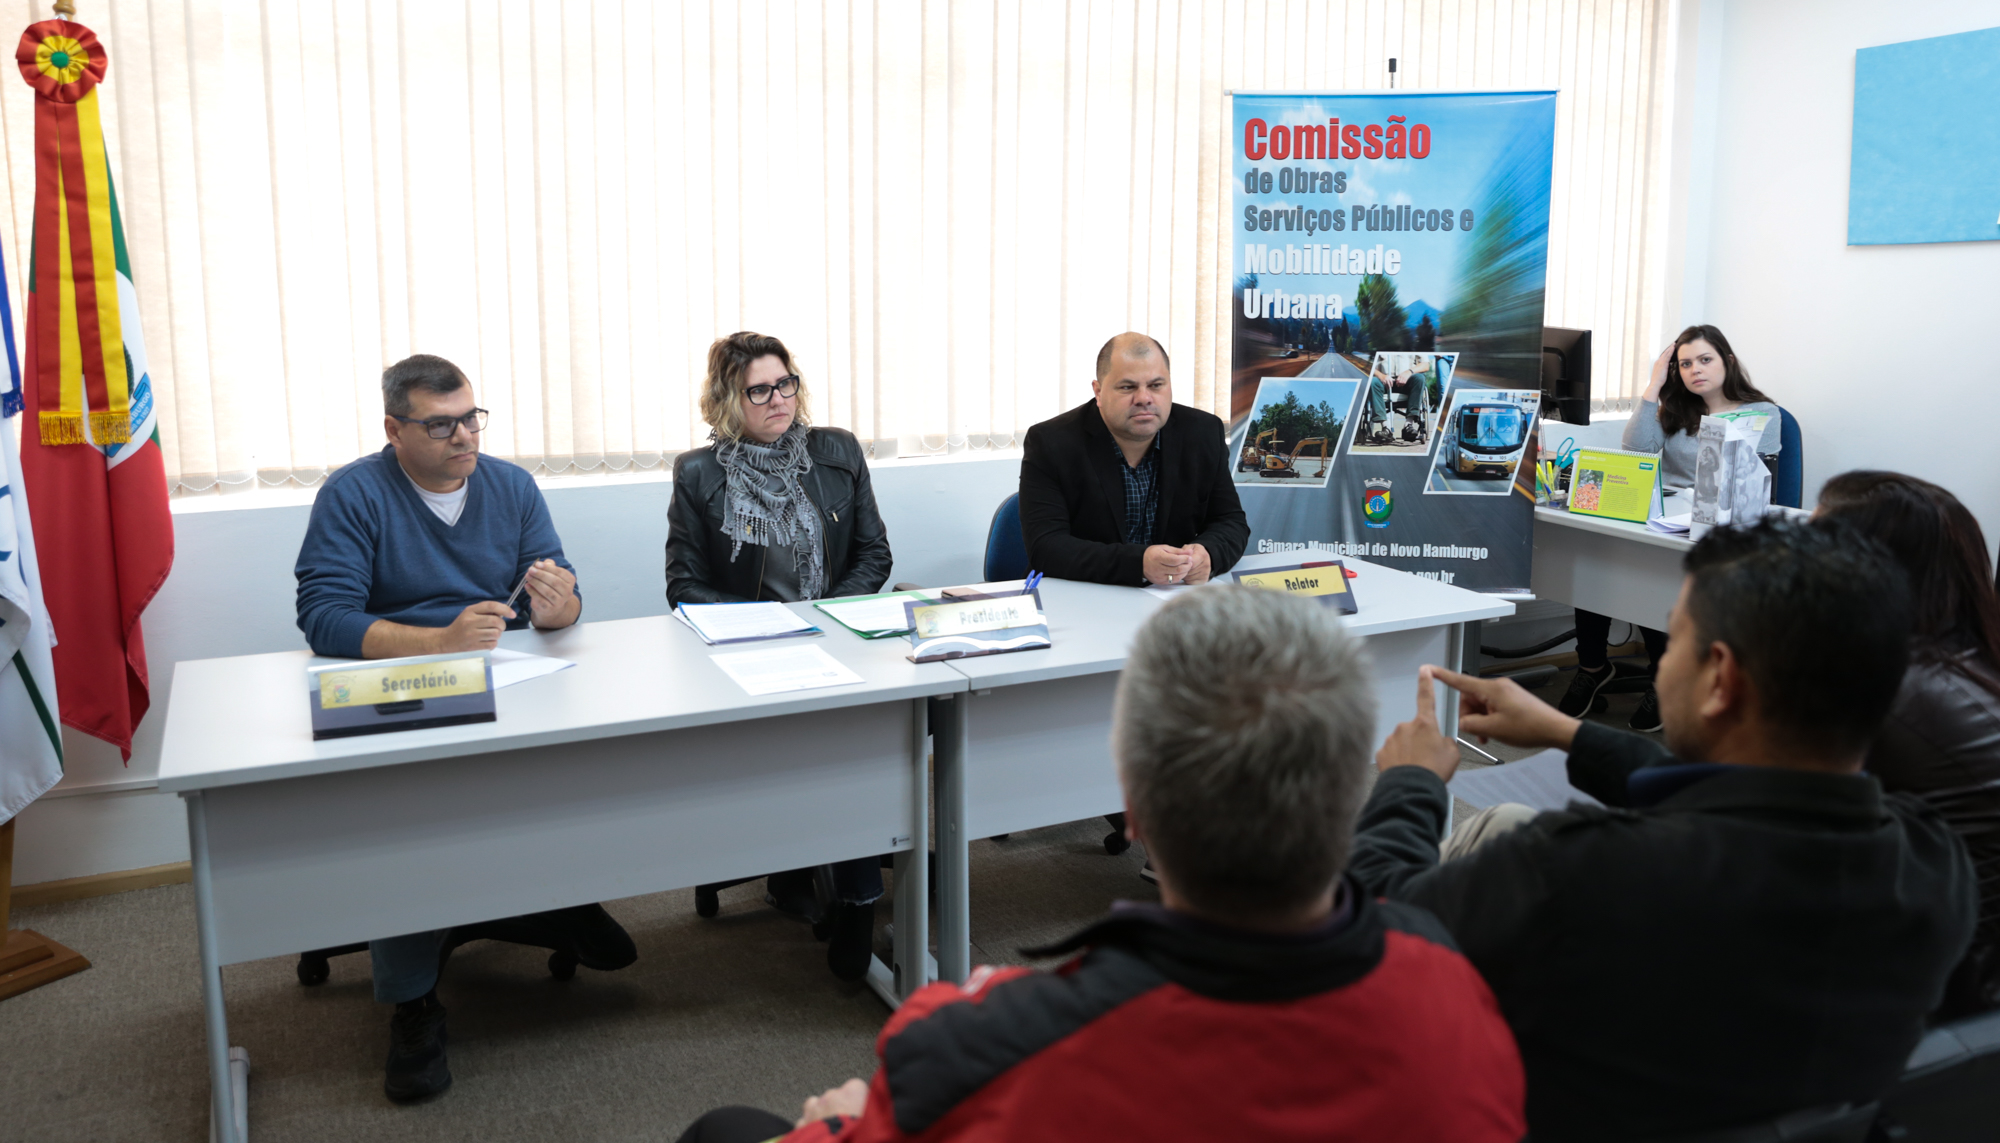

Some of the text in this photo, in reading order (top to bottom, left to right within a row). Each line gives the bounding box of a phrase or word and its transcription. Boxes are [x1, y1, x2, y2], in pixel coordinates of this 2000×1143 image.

[1244, 115, 1431, 160] Comissão
[1244, 167, 1347, 194] de Obras
[1244, 204, 1474, 236] Serviços Públicos e
[1244, 243, 1401, 275] Mobilidade
[1243, 288, 1343, 320] Urbana
[1257, 539, 1489, 561] Câmara Municipal de Novo Hamburgo
[1284, 577, 1320, 591] Relator
[959, 607, 1020, 625] Presidente
[382, 670, 458, 693] Secretário
